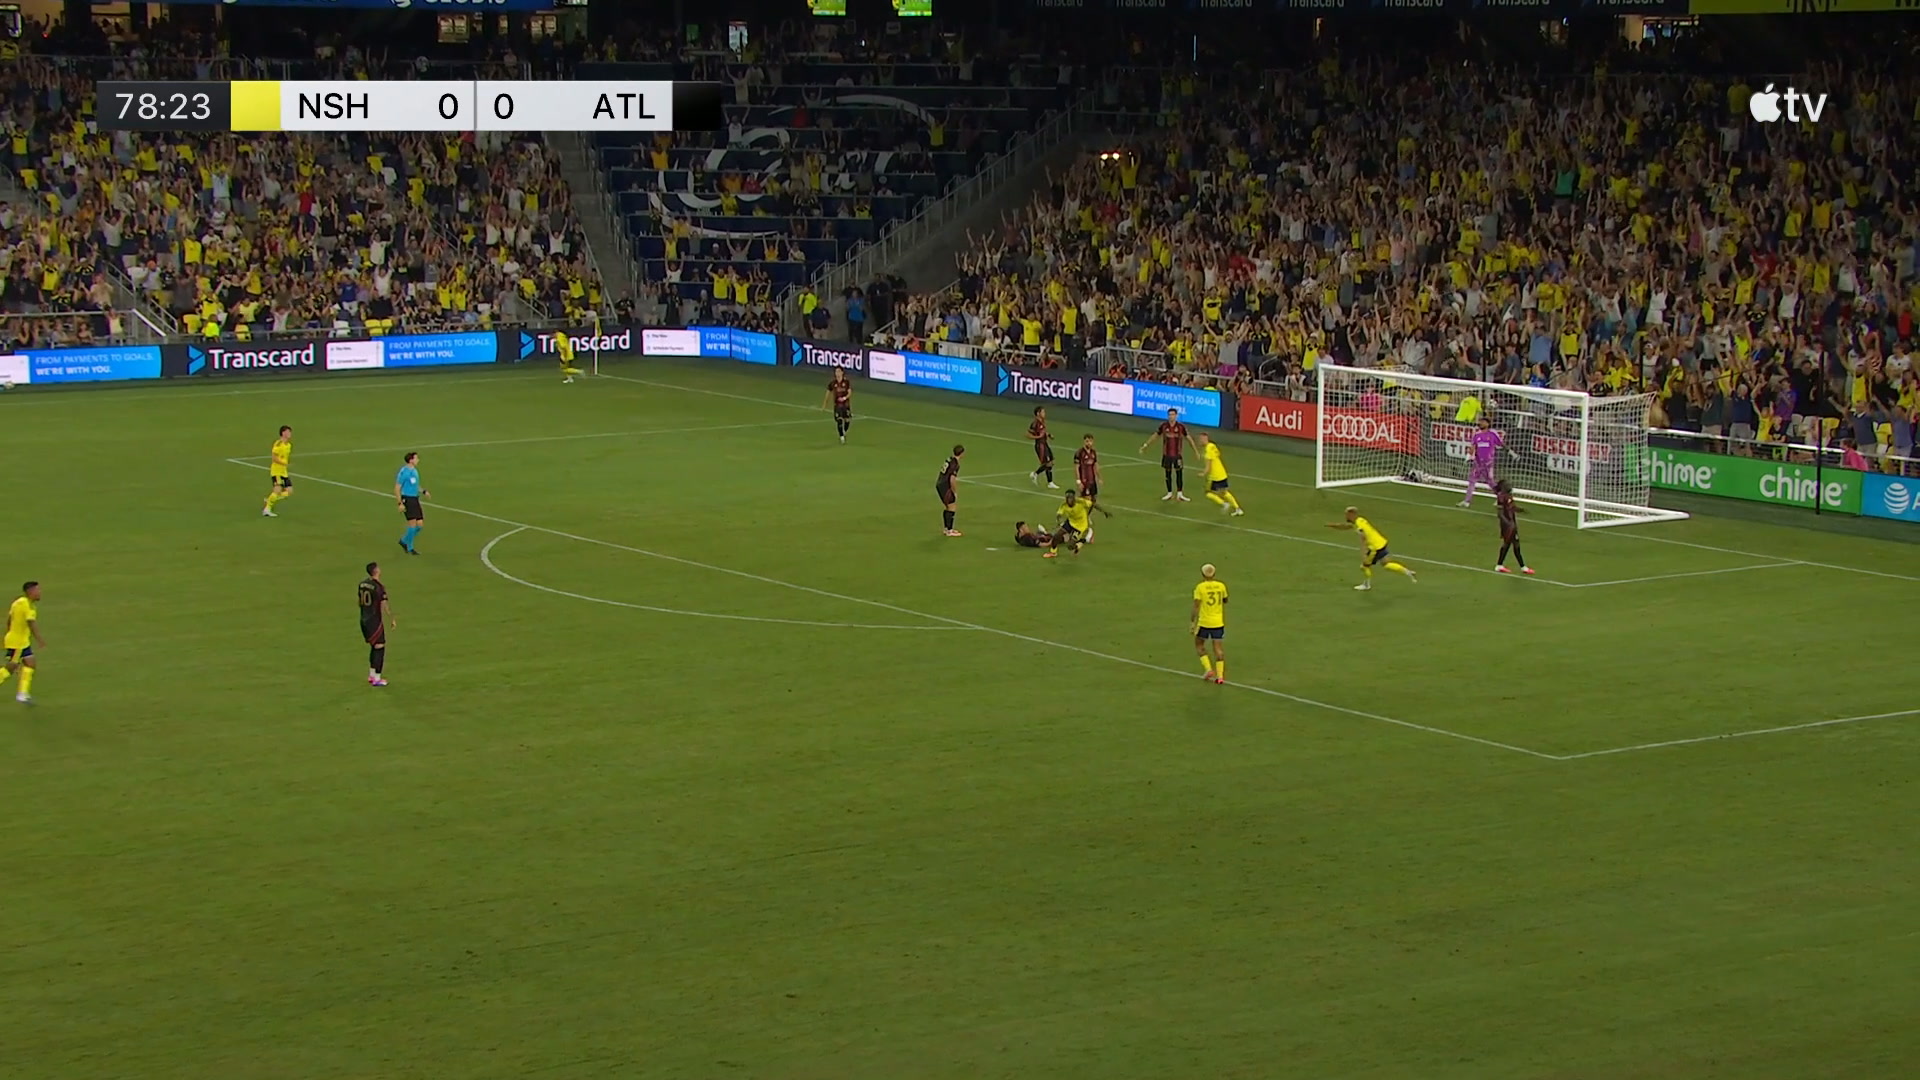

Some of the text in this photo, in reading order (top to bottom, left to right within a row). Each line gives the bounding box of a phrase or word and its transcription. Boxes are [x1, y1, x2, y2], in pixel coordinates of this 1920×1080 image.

[389, 342, 411, 350] FROM
[413, 340, 452, 349] PAYMENTS
[454, 339, 463, 347] TO
[538, 329, 630, 353] Trnscard
[36, 356, 61, 364] FROM
[63, 354, 109, 363] PAYMENTS
[111, 353, 121, 362] TO
[208, 343, 314, 369] Transcard
[389, 352, 413, 360] WE'RE
[415, 351, 436, 359] WITH
[803, 344, 863, 370] Transcard
[36, 367, 63, 376] WE'RE
[65, 366, 89, 375] WITH
[1011, 371, 1081, 400] Transcard
[1256, 405, 1303, 431] Audi
[1532, 435, 1609, 462] DISCONT
[1552, 457, 1581, 470] TIR
[1760, 467, 1842, 507] chime
[360, 590, 372, 606] 10
[1206, 591, 1222, 607] 31
